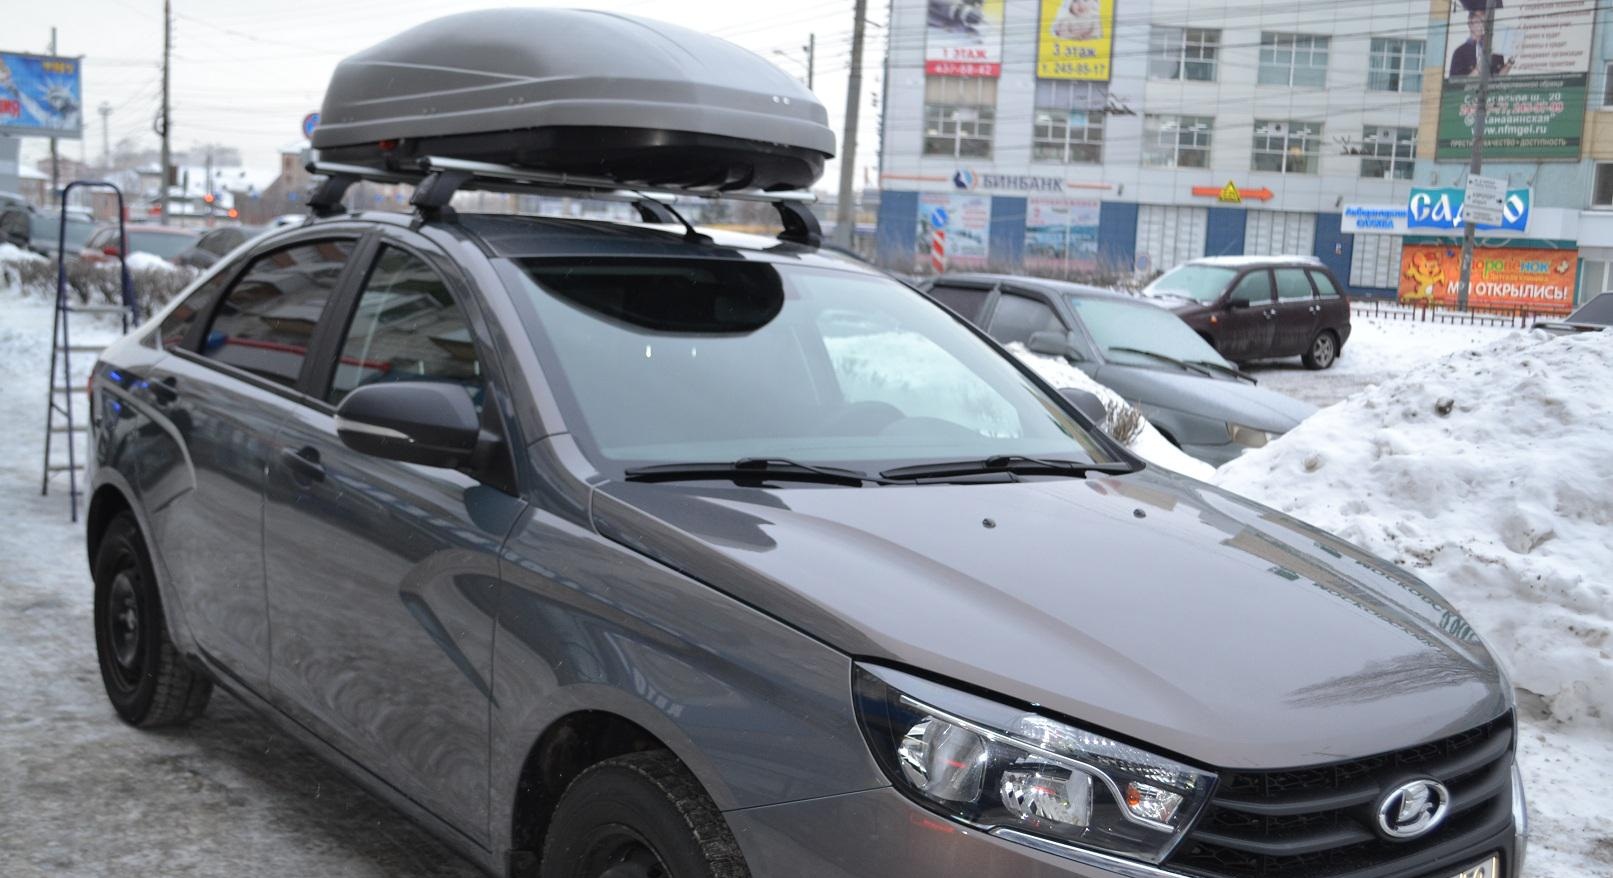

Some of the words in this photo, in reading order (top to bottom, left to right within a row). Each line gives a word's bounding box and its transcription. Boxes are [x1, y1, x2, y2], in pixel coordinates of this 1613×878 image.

[953, 48, 987, 59] ЭТАЖ
[1053, 44, 1060, 57] 3
[1065, 47, 1097, 58] этаж
[983, 174, 1063, 192] БИНБАНК
[1475, 281, 1567, 300] ОТКРЫЛИСЬ!
